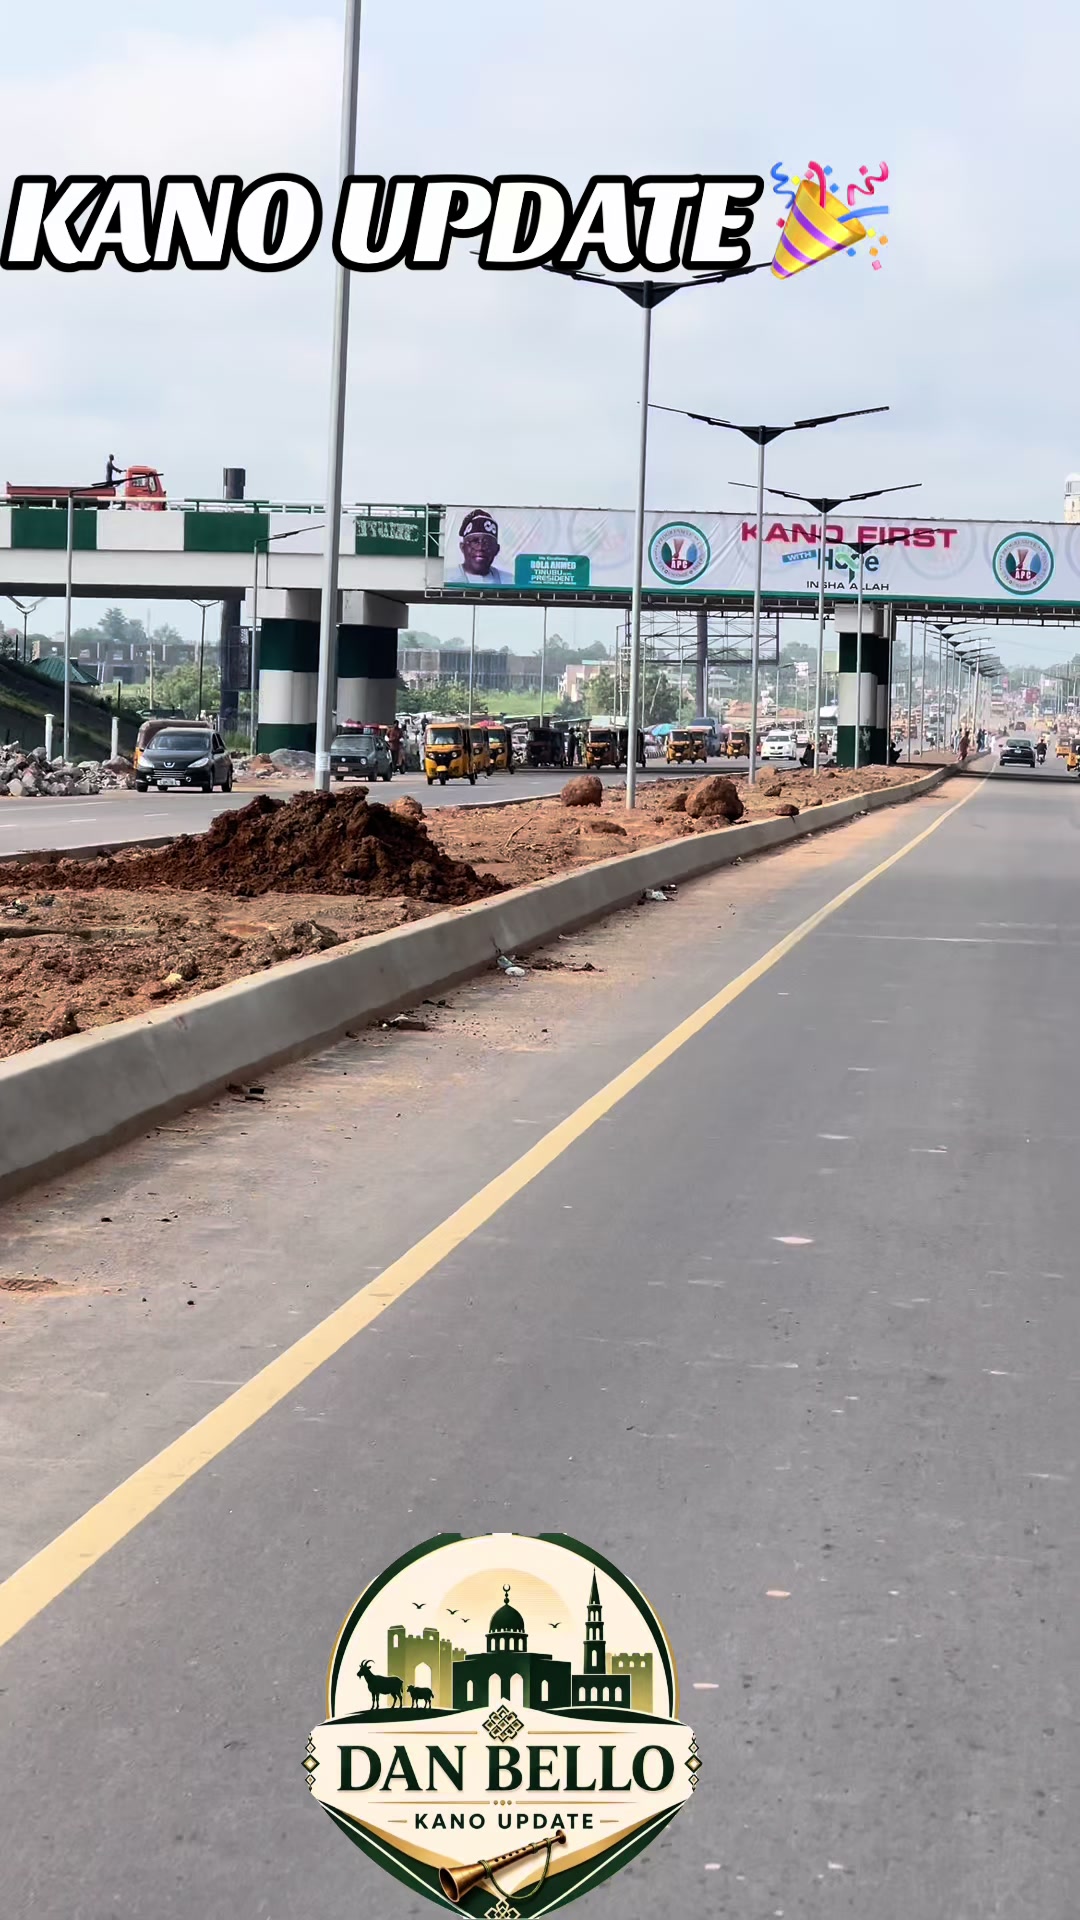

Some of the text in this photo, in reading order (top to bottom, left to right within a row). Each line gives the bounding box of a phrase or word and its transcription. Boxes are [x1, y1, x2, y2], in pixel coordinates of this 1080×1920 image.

[741, 522, 958, 548] KANO FIRST
[787, 551, 812, 561] WITH
[530, 560, 576, 569] BOLA AHMED
[671, 560, 688, 569] APC
[531, 574, 575, 582] PRESIDENT
[1015, 570, 1032, 579] APC
[849, 582, 890, 591] ALAH
